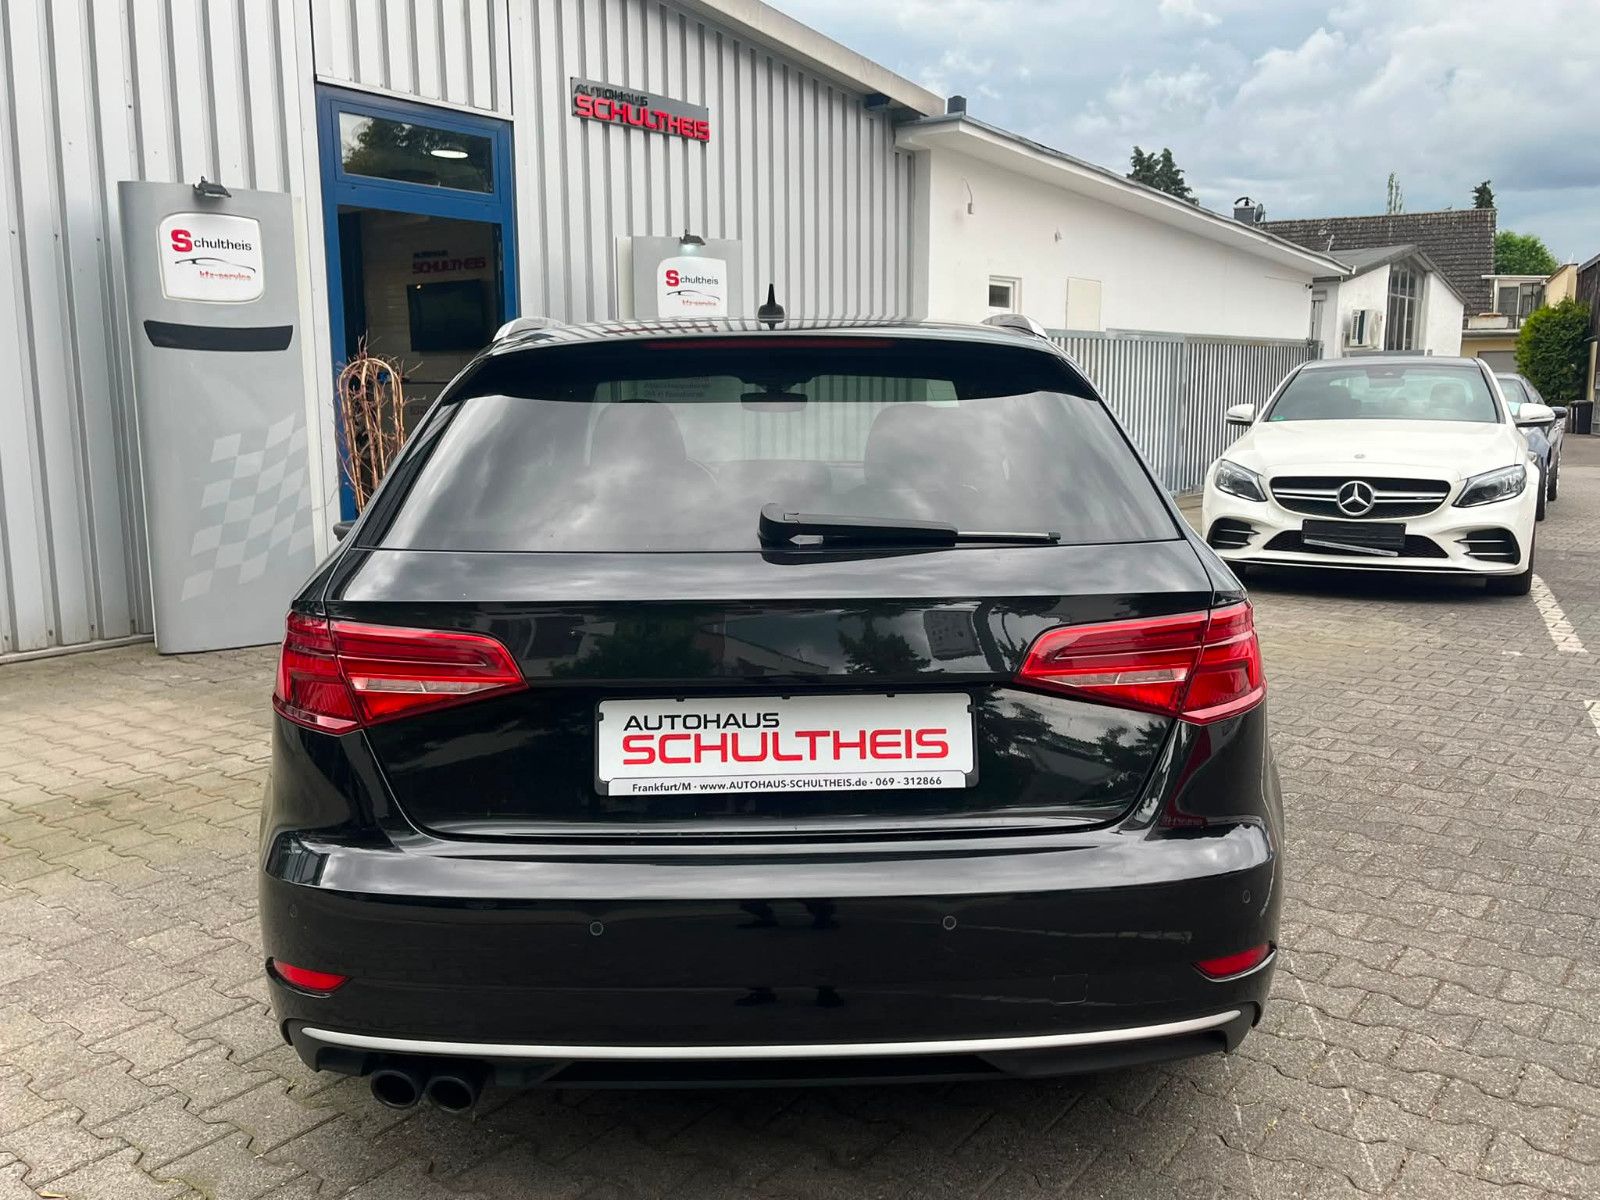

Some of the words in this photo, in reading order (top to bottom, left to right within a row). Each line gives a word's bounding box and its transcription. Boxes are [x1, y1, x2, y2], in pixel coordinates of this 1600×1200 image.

[575, 84, 648, 106] AUTOHAUS
[576, 94, 710, 141] SCHULTHEIS
[171, 229, 252, 252] Schultheis
[666, 269, 719, 287] Schultheis
[623, 712, 780, 731] AUTOHAUS
[622, 728, 949, 765] SCHULTHEIS
[632, 782, 692, 792] Frankfurt/M
[700, 777, 867, 790] www.AUTOHAUS-SCHULTHEIS.de
[875, 777, 895, 786] 069
[903, 776, 942, 785] 312866
